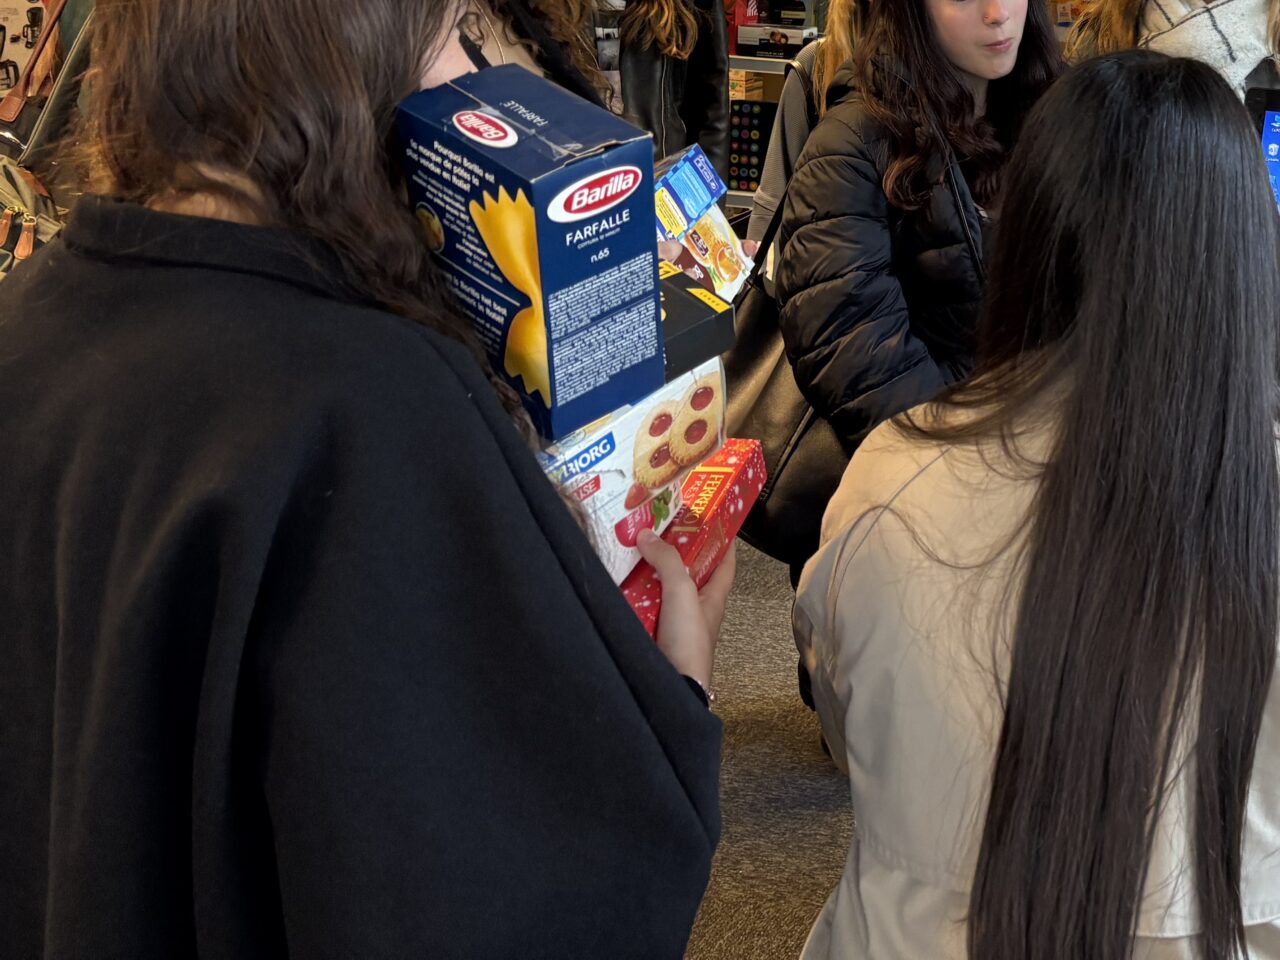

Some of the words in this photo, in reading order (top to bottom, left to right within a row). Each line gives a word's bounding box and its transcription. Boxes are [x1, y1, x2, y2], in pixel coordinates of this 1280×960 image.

[460, 113, 505, 139] Barilla
[504, 100, 548, 127] FARFALLE
[418, 145, 442, 164] marque
[442, 159, 453, 170] de
[453, 165, 471, 181] pâtes
[471, 174, 480, 187] la
[419, 157, 441, 175] vendue
[442, 170, 452, 181] en
[433, 140, 462, 164] Pourquoi
[462, 157, 484, 177] Barilla
[484, 172, 495, 184] est
[570, 172, 635, 212] Barilla
[565, 208, 631, 246] FARFALLE
[460, 280, 480, 300] Barilla
[685, 474, 726, 526] FERRERO
